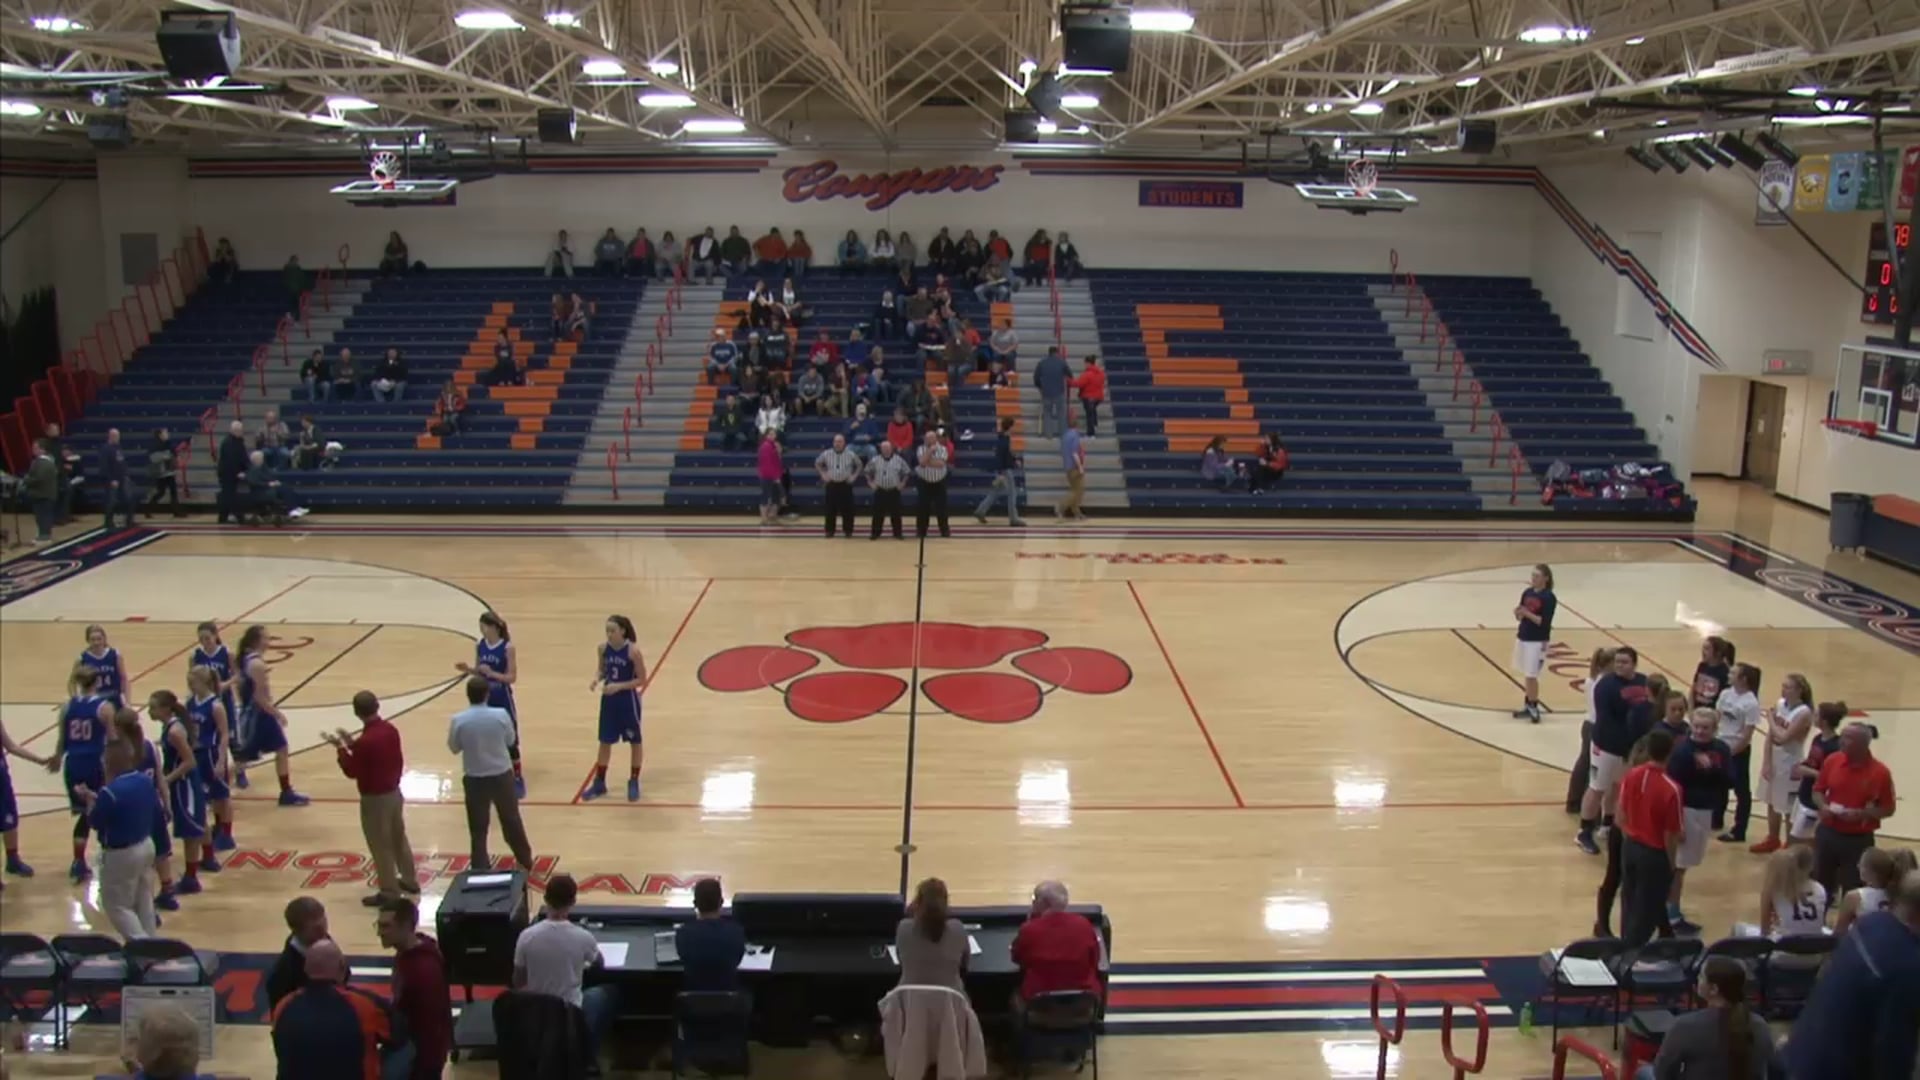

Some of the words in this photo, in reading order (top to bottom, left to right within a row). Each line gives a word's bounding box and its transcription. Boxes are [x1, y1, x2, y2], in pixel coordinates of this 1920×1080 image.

[782, 160, 1004, 211] Cougars
[1147, 190, 1236, 206] STUDENTS
[1880, 263, 1891, 285] 0
[69, 719, 93, 740] 20
[1793, 901, 1818, 921] 15
